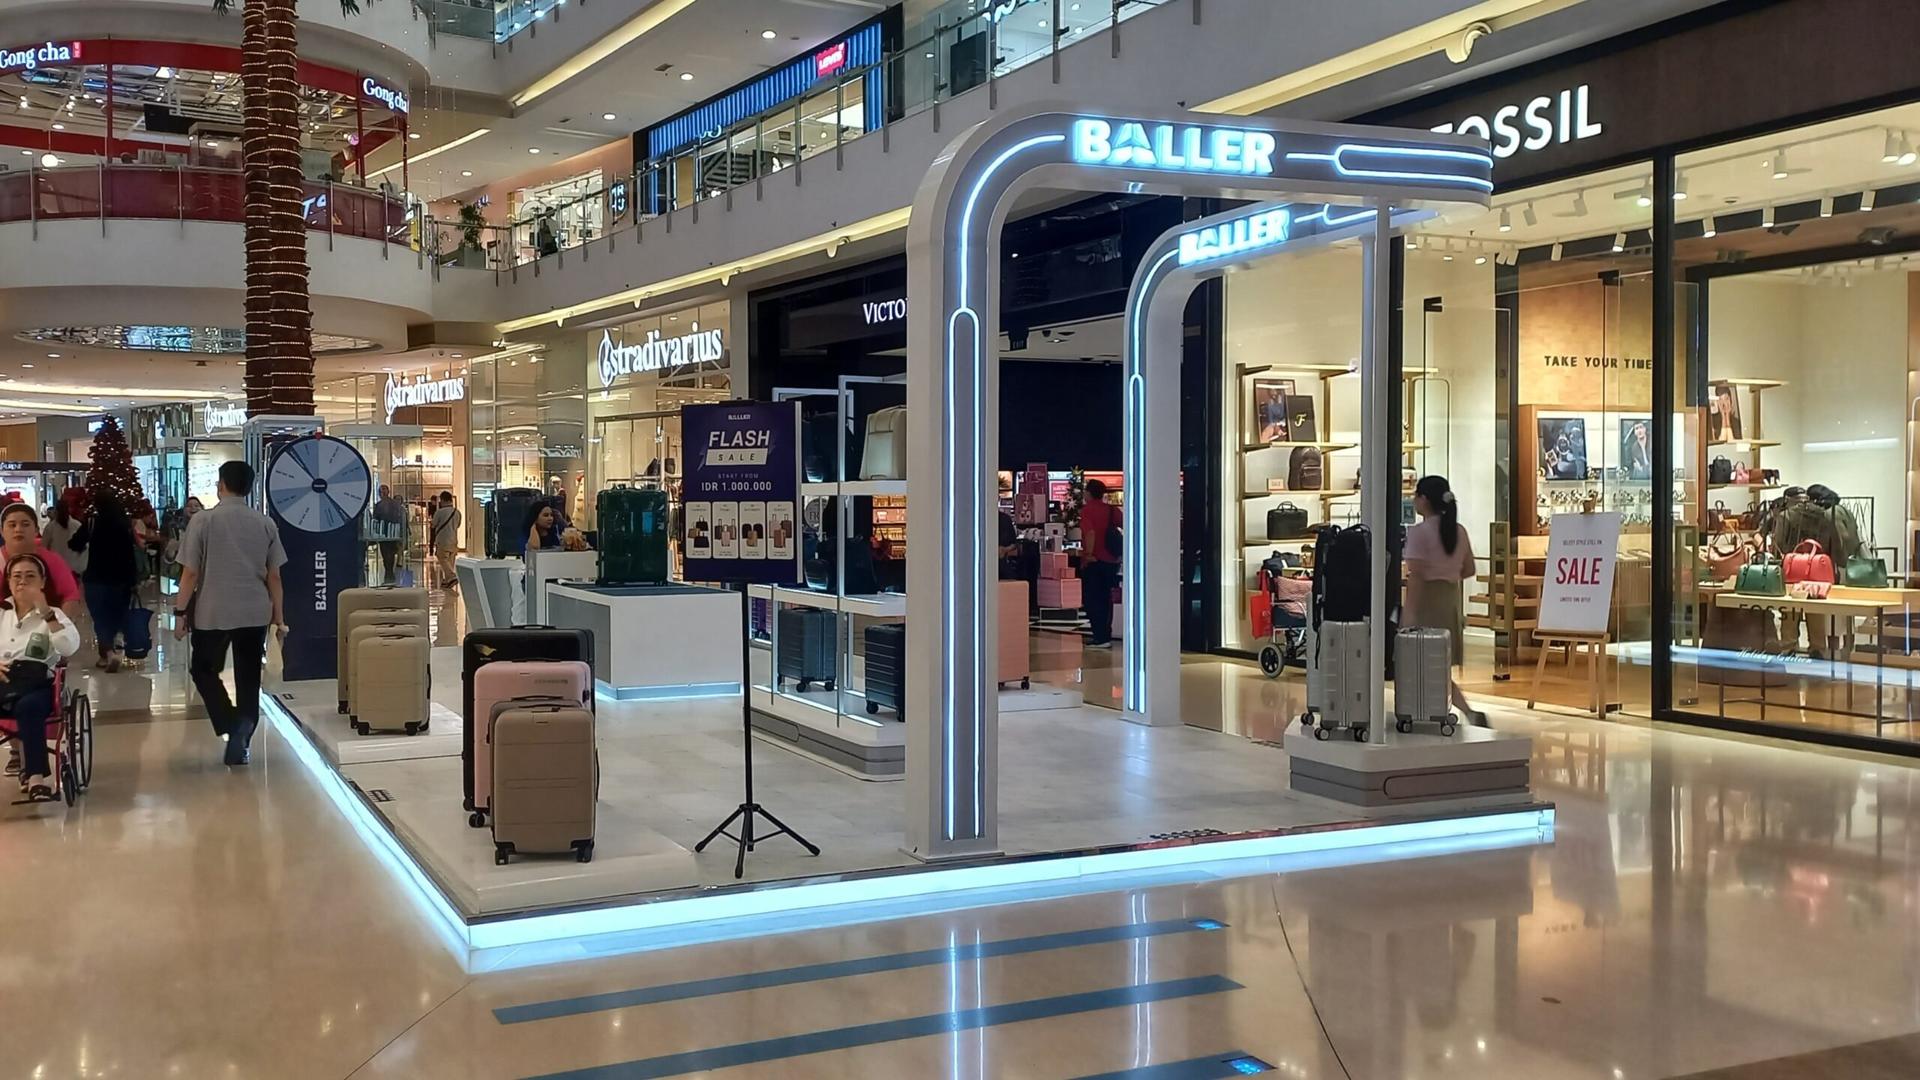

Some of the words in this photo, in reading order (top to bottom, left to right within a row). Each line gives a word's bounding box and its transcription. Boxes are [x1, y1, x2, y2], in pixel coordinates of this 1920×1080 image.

[0, 48, 36, 69] Gong
[38, 42, 70, 62] cha
[363, 78, 395, 110] Gong
[1429, 84, 1602, 159] SSIL
[1073, 118, 1276, 175] BALLER
[1178, 209, 1290, 265] BALLER
[863, 298, 908, 325] VICTO
[599, 322, 722, 384] stradivarius
[1544, 355, 1578, 367] TAKE
[1584, 357, 1618, 369] YOUR
[1624, 358, 1652, 370] TIME
[385, 372, 465, 416] stradivarius
[708, 430, 770, 447] FLASH
[718, 453, 755, 461] SALE
[701, 482, 719, 491] IDR
[722, 481, 772, 491] 1.000.000
[315, 551, 327, 611] BALLER
[1556, 557, 1602, 585] SALE
